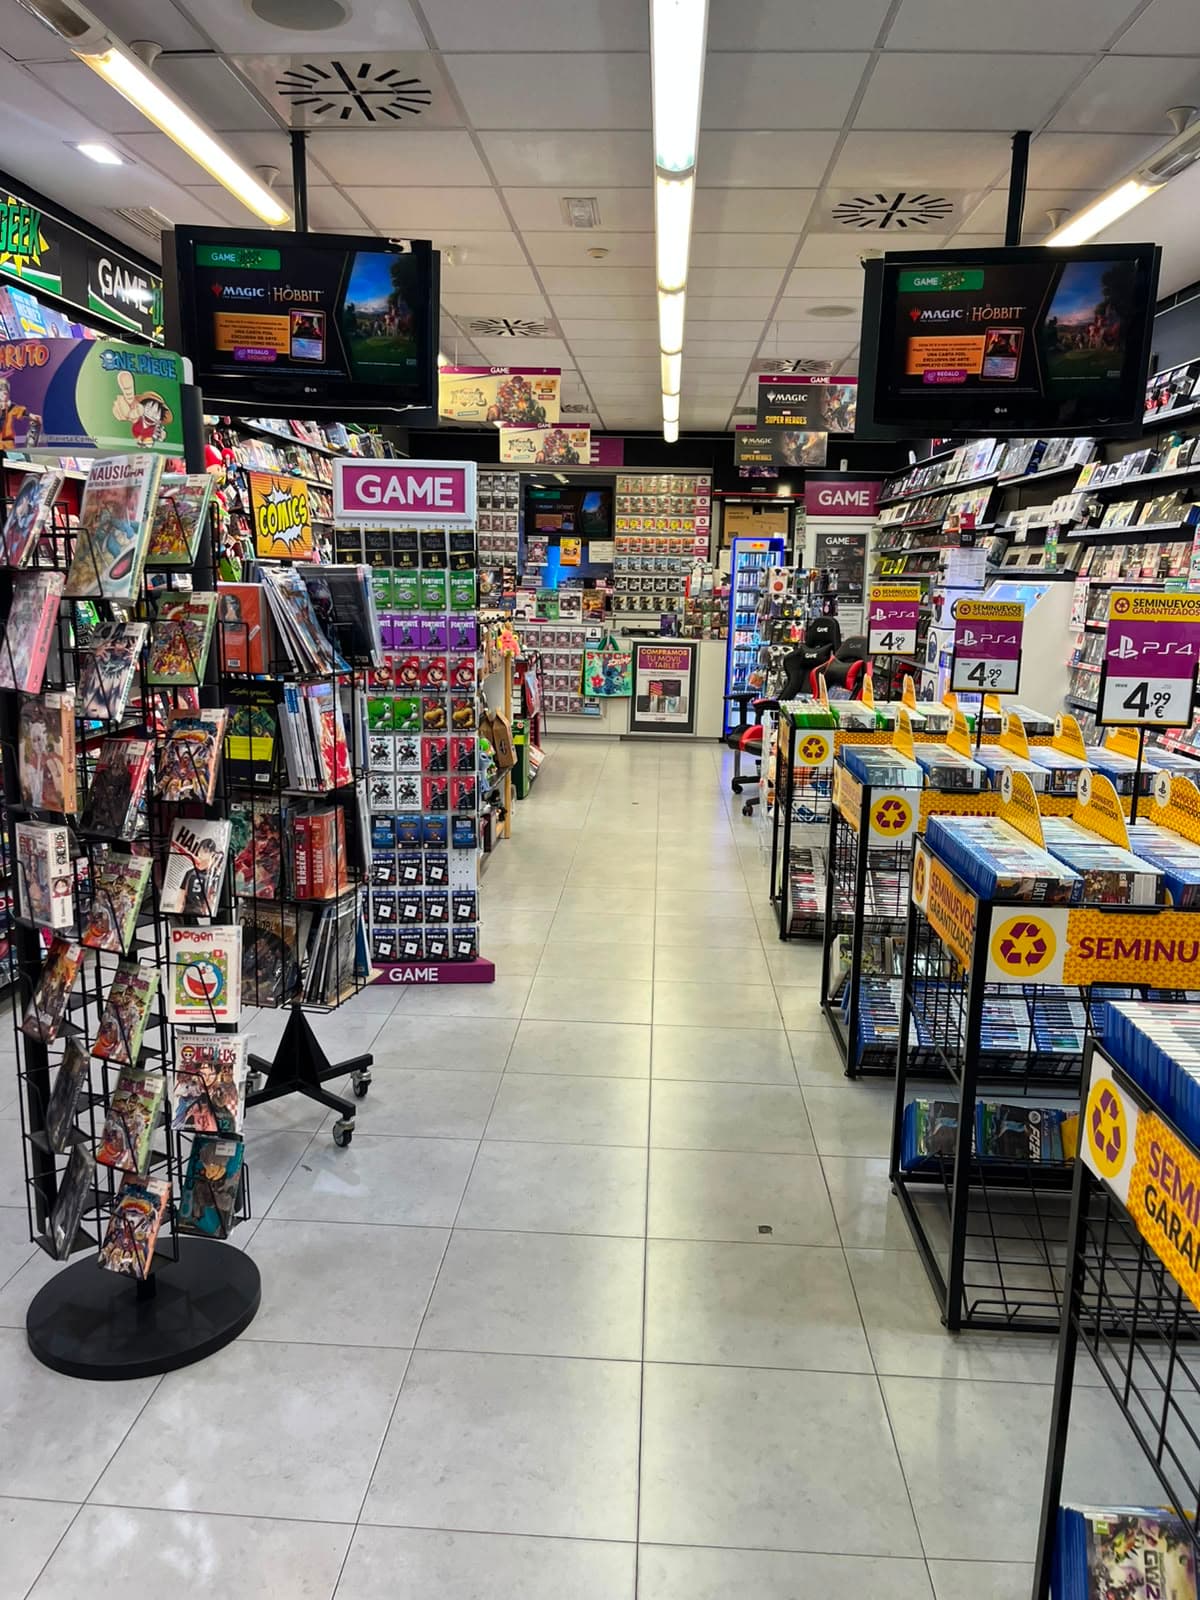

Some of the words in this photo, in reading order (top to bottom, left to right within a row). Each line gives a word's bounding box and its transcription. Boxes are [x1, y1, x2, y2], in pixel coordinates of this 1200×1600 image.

[211, 252, 236, 262] GAME
[98, 258, 149, 315] GAME
[914, 277, 938, 286] GAME
[222, 286, 265, 297] MAGIC
[273, 285, 322, 302] HOBBIT
[920, 309, 963, 319] MAGIC
[972, 304, 1023, 321] HOBBIT
[138, 353, 177, 379] PIECE
[490, 366, 510, 374] GAME
[810, 376, 830, 384] GAME
[775, 393, 808, 401] MAGIC
[764, 415, 784, 425] SUPER
[785, 415, 808, 425] HEROES
[355, 474, 453, 507] GAME
[818, 490, 870, 506] GAME
[259, 494, 309, 536] COMICS
[825, 536, 849, 545] GAME
[973, 604, 1022, 612] SEMINUEVOS
[1133, 598, 1200, 608] SEMINUEVOS
[888, 610, 915, 618] PS4
[1133, 608, 1200, 616] GARANTIZADOS
[980, 634, 1016, 644] PS4
[641, 648, 688, 656] COMPRAMOS
[1142, 641, 1193, 655] PS4
[931, 871, 976, 936] SEMINUEVOS
[1078, 936, 1200, 963] SEMINU
[389, 968, 439, 981] GAME
[220, 1120, 230, 1129] 12
